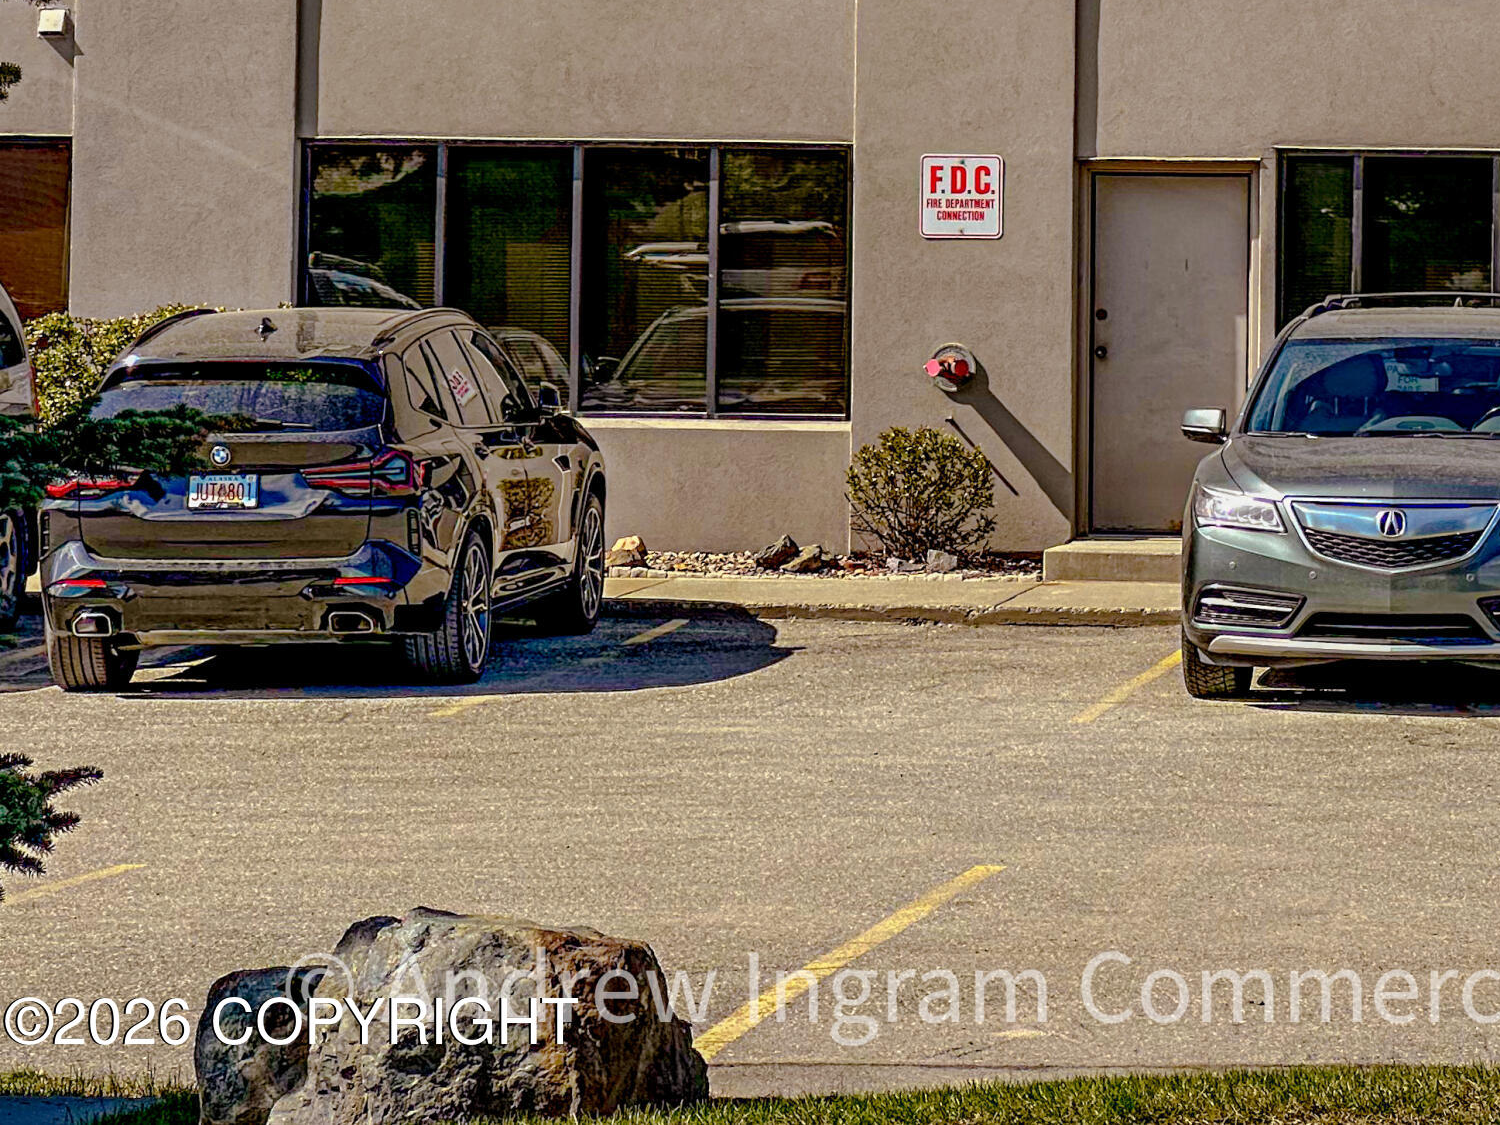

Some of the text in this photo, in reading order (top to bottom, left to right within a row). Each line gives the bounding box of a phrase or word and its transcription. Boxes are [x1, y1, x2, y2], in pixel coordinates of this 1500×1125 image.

[930, 165, 995, 195] F.D.C.
[926, 198, 995, 209] FIRE DEPARTMENT
[936, 210, 985, 221] CONNECTION
